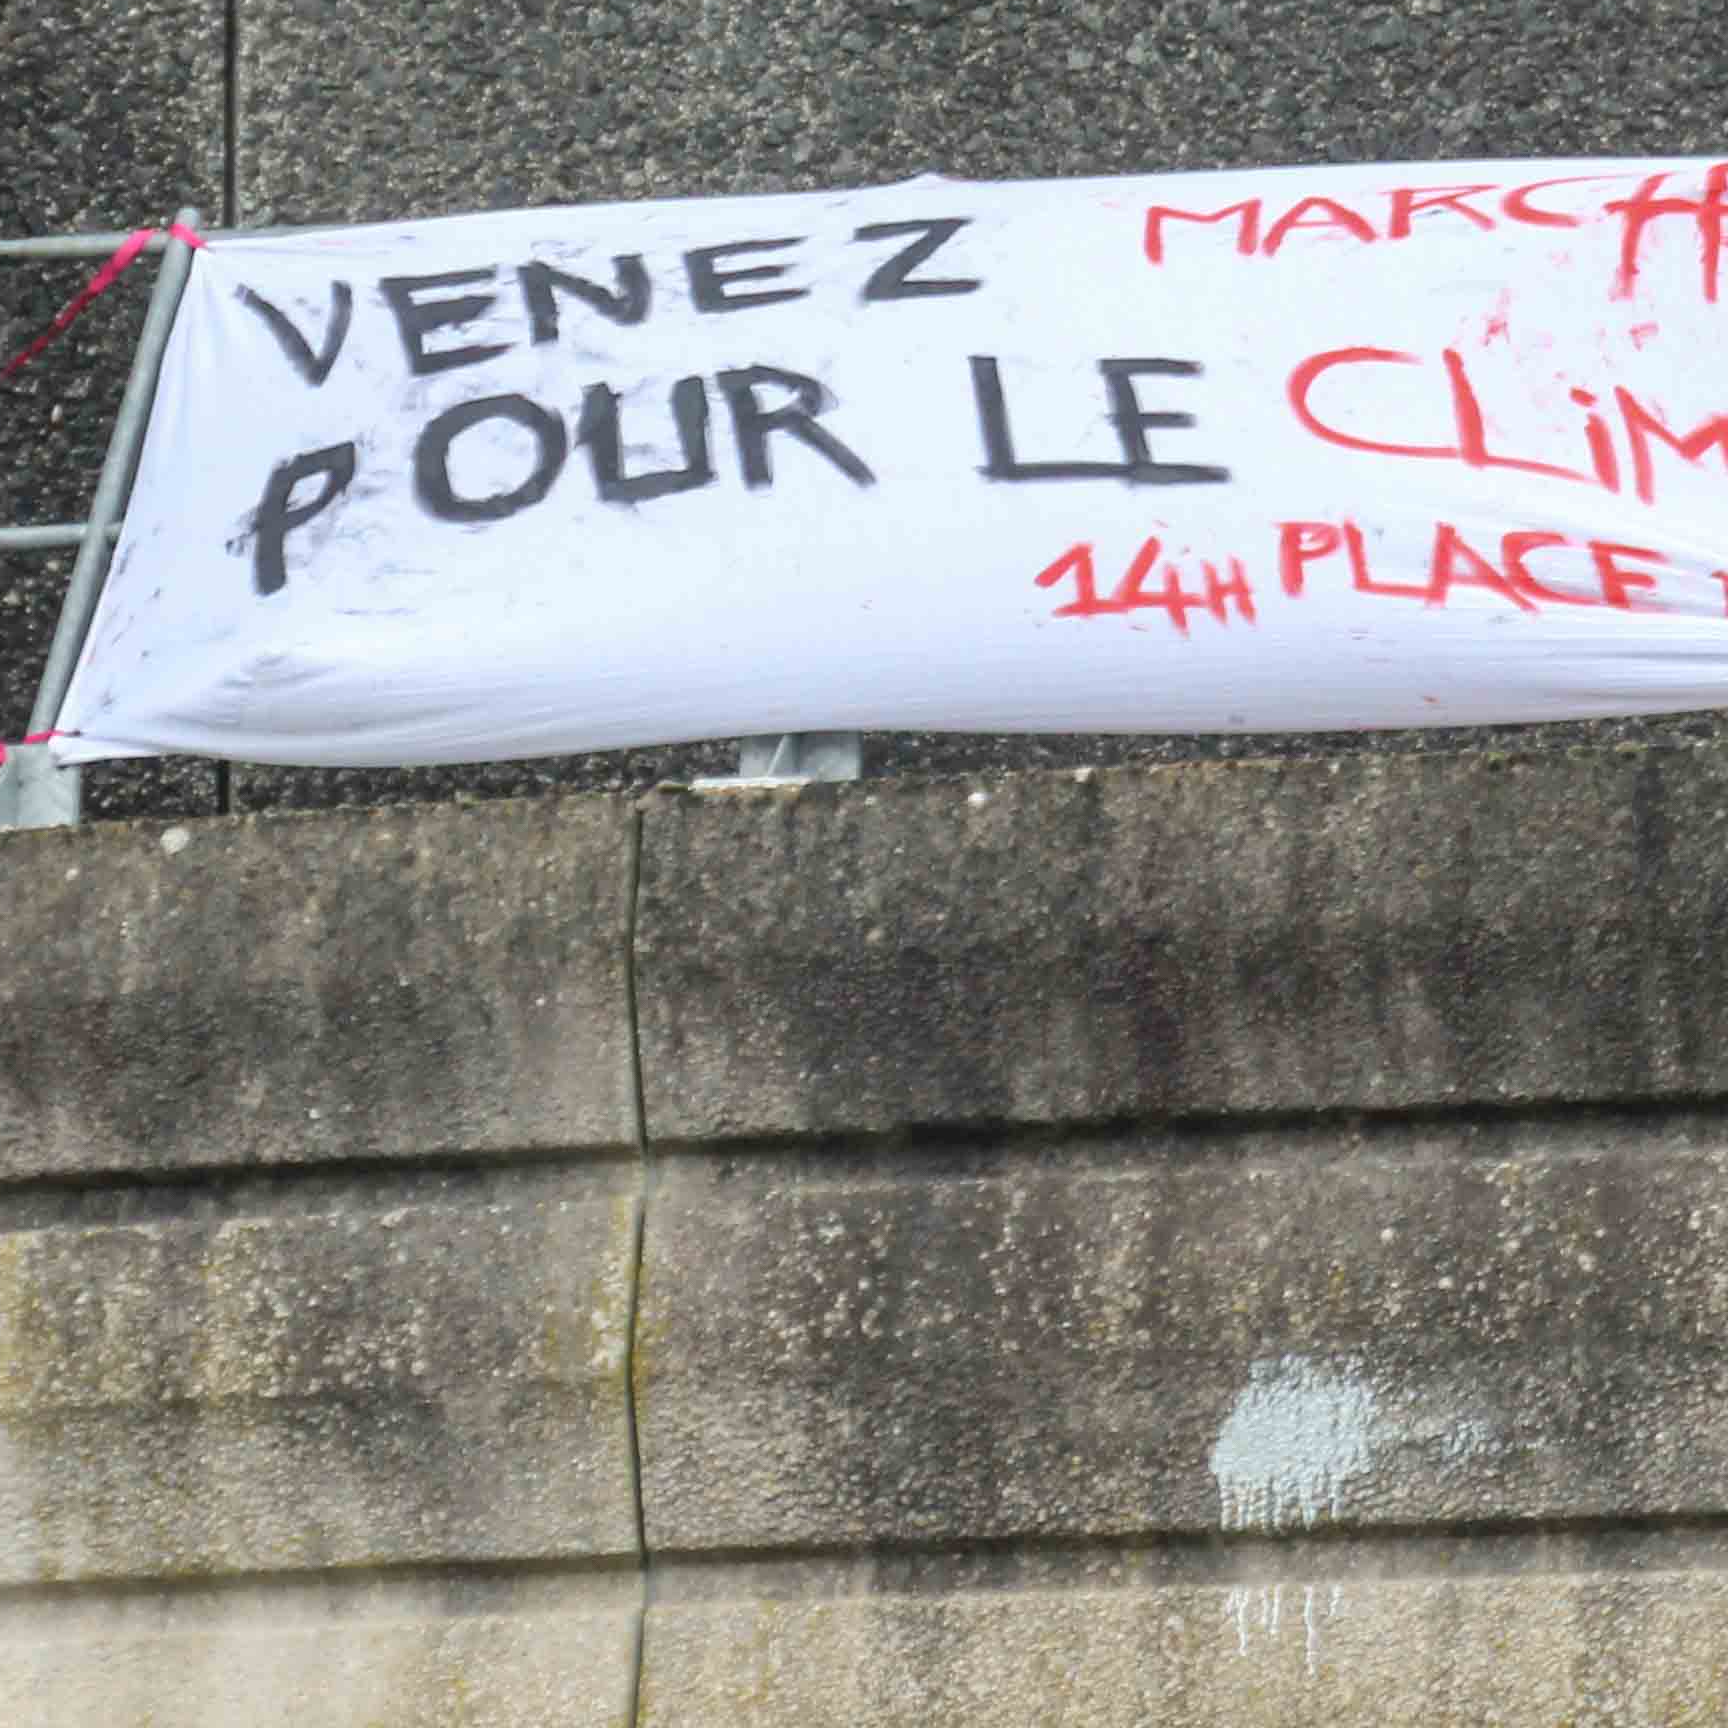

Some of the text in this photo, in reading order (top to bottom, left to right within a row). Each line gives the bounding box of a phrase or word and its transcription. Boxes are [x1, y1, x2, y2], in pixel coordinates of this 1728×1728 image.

[236, 216, 980, 386] VENEZ
[242, 364, 876, 596] POUR
[968, 354, 1230, 486] LE
[1275, 515, 1672, 614] PLACE
